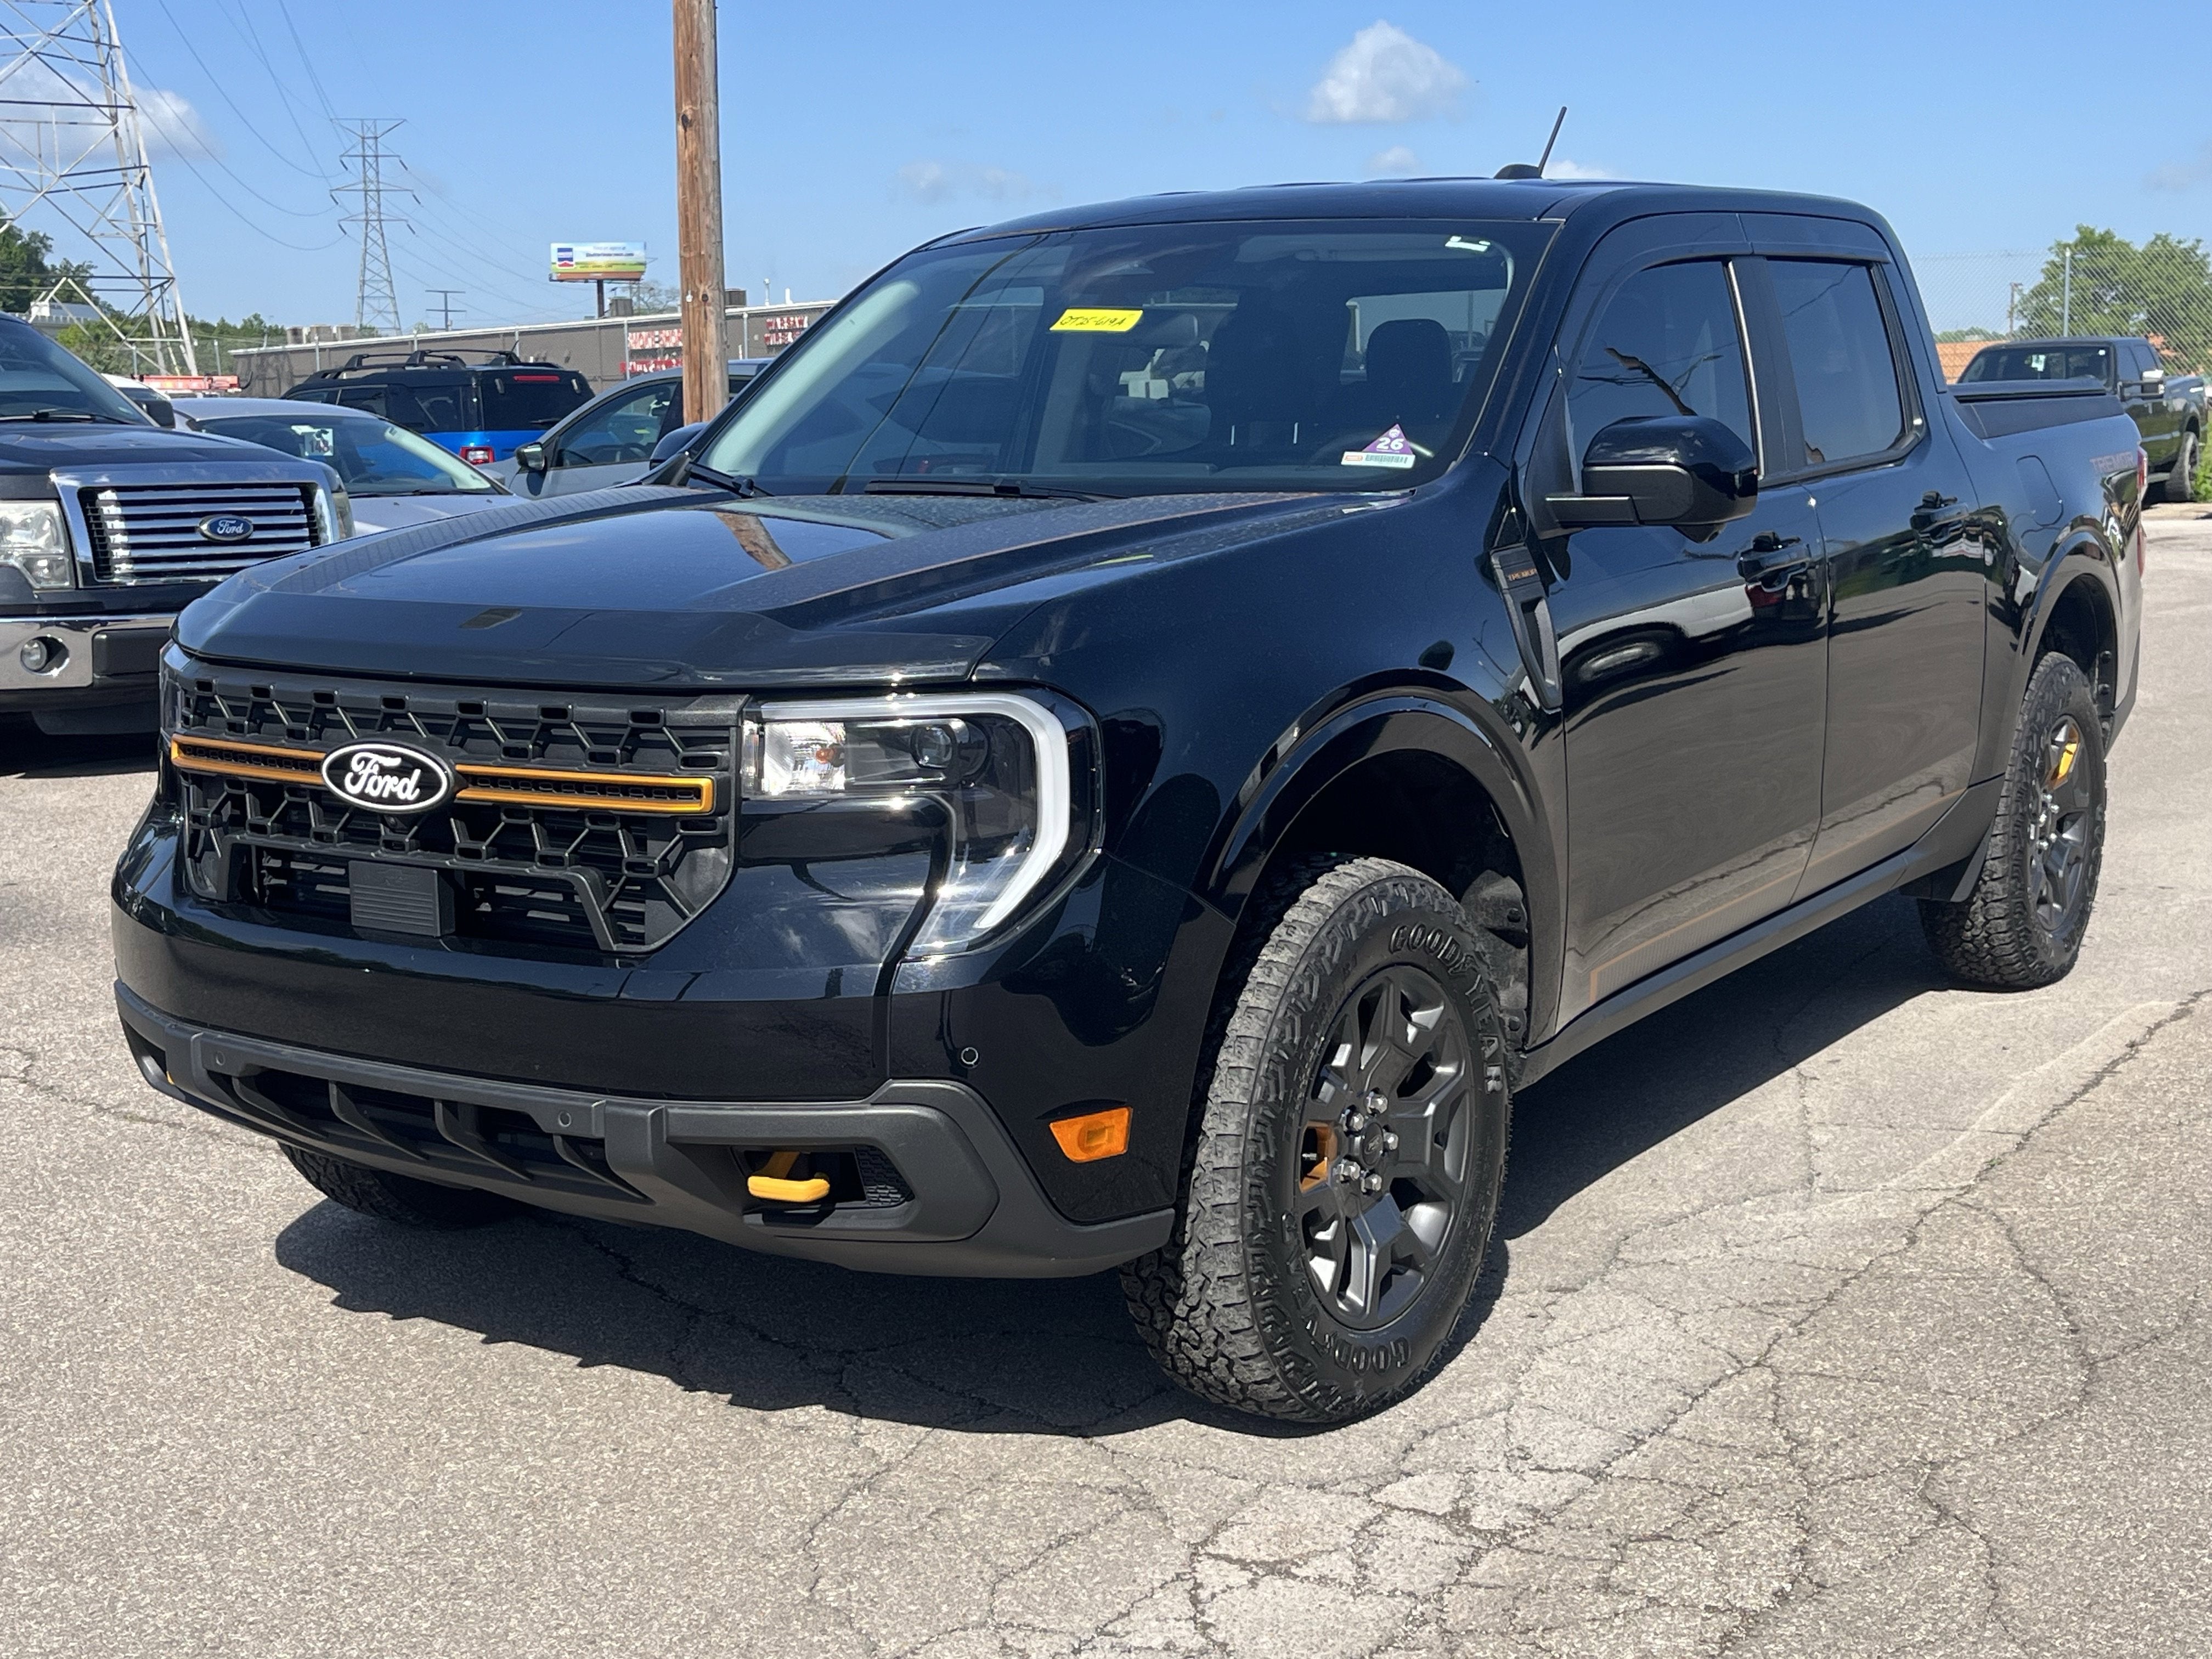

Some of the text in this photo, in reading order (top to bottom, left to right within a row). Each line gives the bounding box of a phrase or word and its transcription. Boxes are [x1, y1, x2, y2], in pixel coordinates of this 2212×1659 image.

[1376, 437, 1404, 450] 26
[2089, 451, 2135, 473] TREMOR
[217, 519, 244, 534] Ford
[344, 752, 421, 801] Ford
